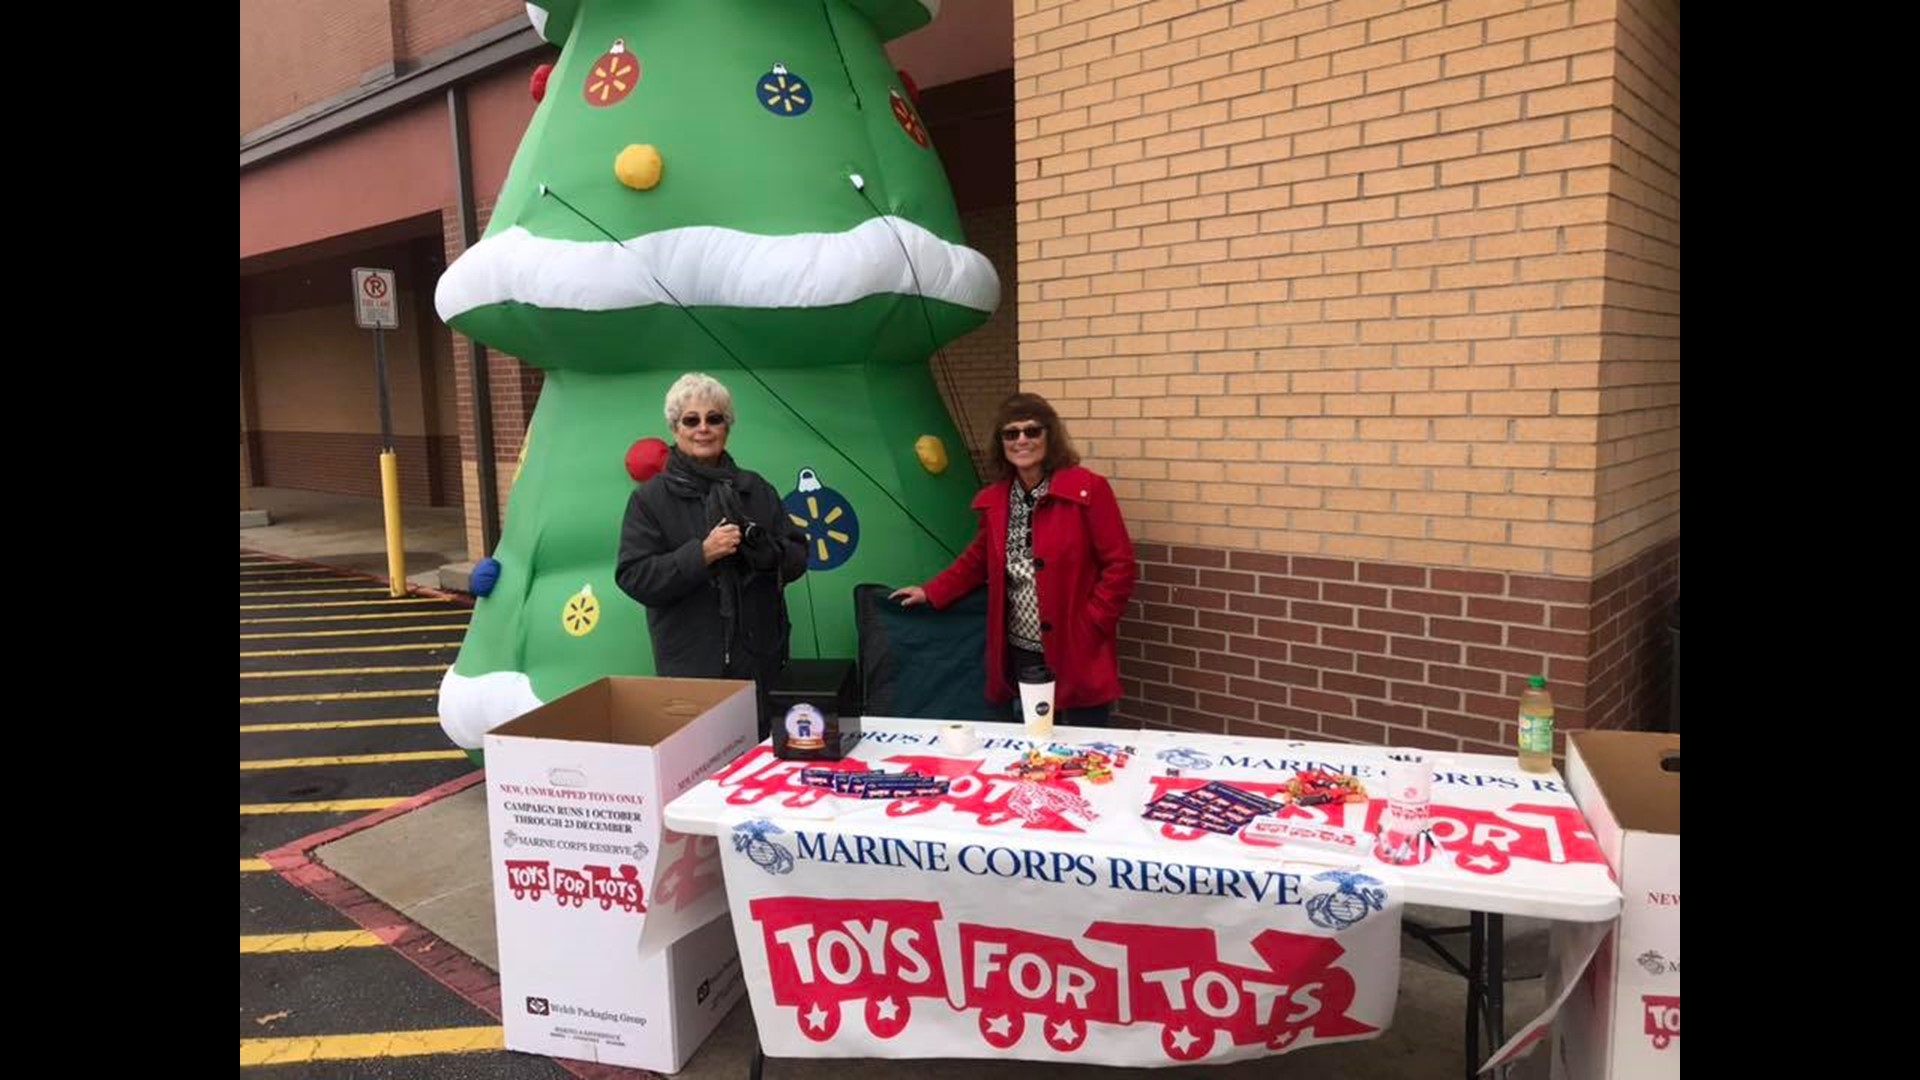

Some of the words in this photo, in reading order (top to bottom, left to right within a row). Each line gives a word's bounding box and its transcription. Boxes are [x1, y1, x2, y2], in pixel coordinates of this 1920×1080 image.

[1219, 755, 1371, 779] MARINE
[525, 786, 587, 799] UNWRAPPED
[588, 792, 615, 803] TOYS
[616, 794, 644, 805] ONLY
[503, 801, 556, 814] CAMPAIGN
[557, 805, 584, 817] RUNS
[592, 809, 641, 822] OCTOBER
[514, 814, 562, 828] THROUGH
[564, 819, 575, 829] 23
[576, 821, 633, 834] DECEMBER
[518, 836, 556, 849] MARINE
[557, 840, 588, 852] CORPS
[589, 843, 633, 856] RESERVE
[794, 830, 950, 873] MARINE
[958, 844, 1098, 887] CORPS
[1106, 857, 1303, 906] RESERVE
[509, 865, 548, 887] TOYS
[556, 872, 586, 895] FOR
[594, 878, 638, 903] TOTS
[774, 918, 931, 985] TOYS
[973, 940, 1096, 1009] FOR
[1141, 967, 1324, 1026] TOTS
[577, 1008, 618, 1022] Packaging
[620, 1013, 647, 1026] Group
[1648, 1005, 1680, 1031] TO
